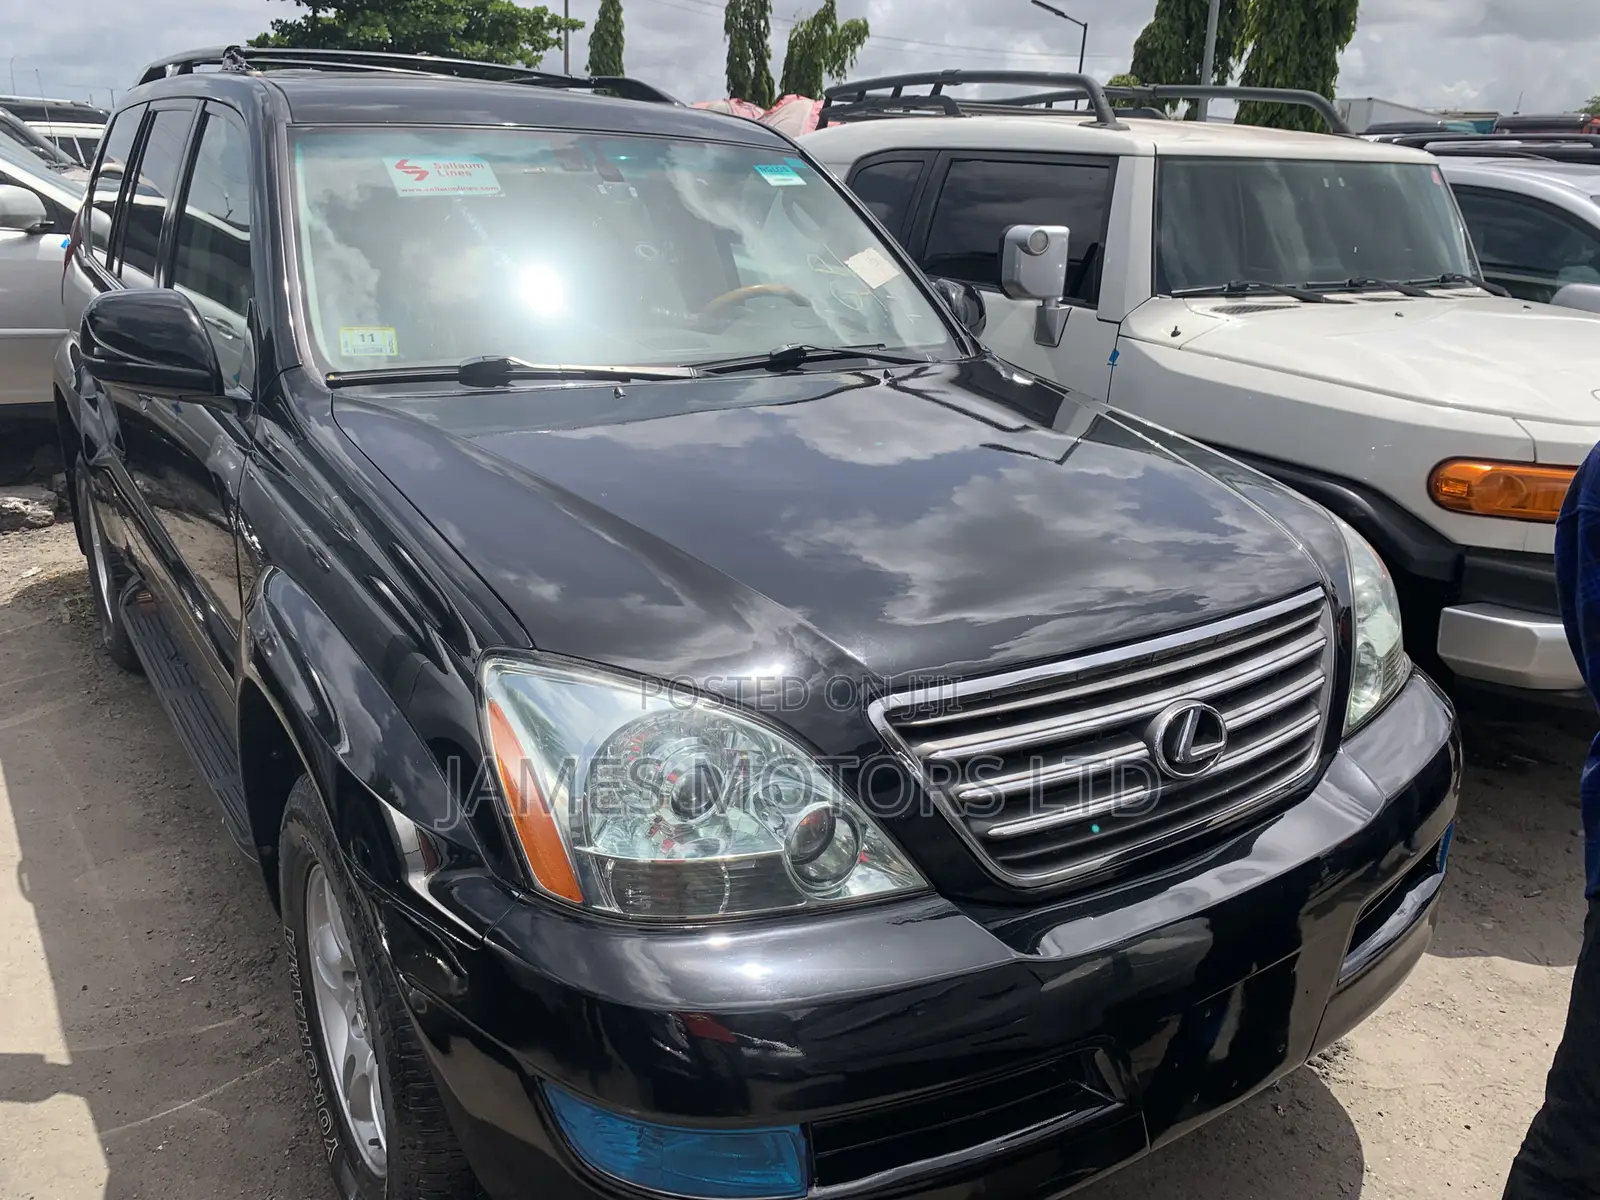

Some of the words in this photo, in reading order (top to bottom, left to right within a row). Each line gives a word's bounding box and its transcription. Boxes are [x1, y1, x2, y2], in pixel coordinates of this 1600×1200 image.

[433, 162, 485, 170] Sallaum
[437, 169, 473, 177] Lines
[359, 333, 375, 343] 11
